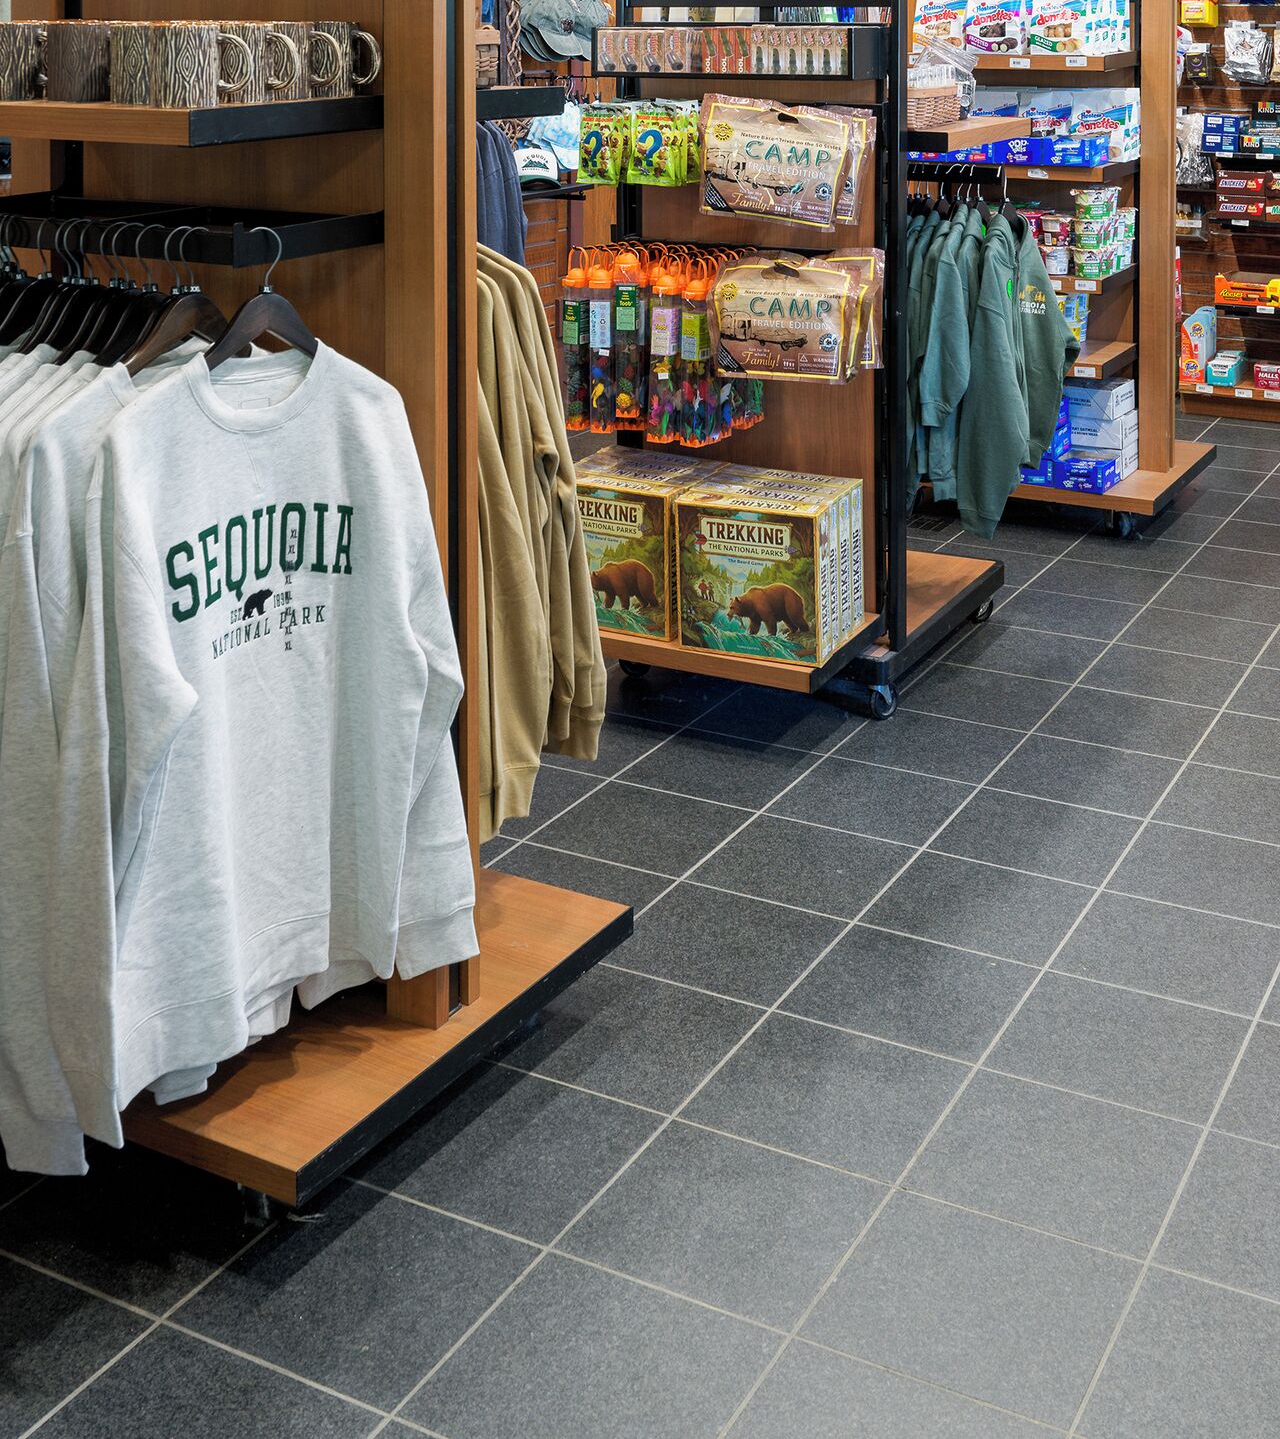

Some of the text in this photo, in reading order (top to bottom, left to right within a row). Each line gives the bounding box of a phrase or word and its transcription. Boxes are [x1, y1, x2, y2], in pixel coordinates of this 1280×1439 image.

[972, 10, 1013, 27] donettes
[741, 132, 760, 140] Nature
[745, 140, 831, 168] CAMP
[747, 162, 826, 179] TRAVEL EDITION
[729, 192, 770, 212] Family!
[750, 296, 832, 322] CAMP
[752, 319, 831, 330] TRAVEL EDITION
[741, 351, 780, 369] Family!
[1258, 372, 1279, 380] HALLS
[577, 499, 638, 523] REKKING
[290, 529, 298, 539] XL
[583, 521, 637, 535] NATIONAL PARKS
[706, 521, 784, 546] TREKKING
[288, 545, 295, 554] XL
[723, 545, 759, 554] NATIONAL
[761, 548, 784, 557] PARKS
[166, 503, 354, 623] SEQUOIA
[212, 604, 326, 659] NATIONAL PARK
